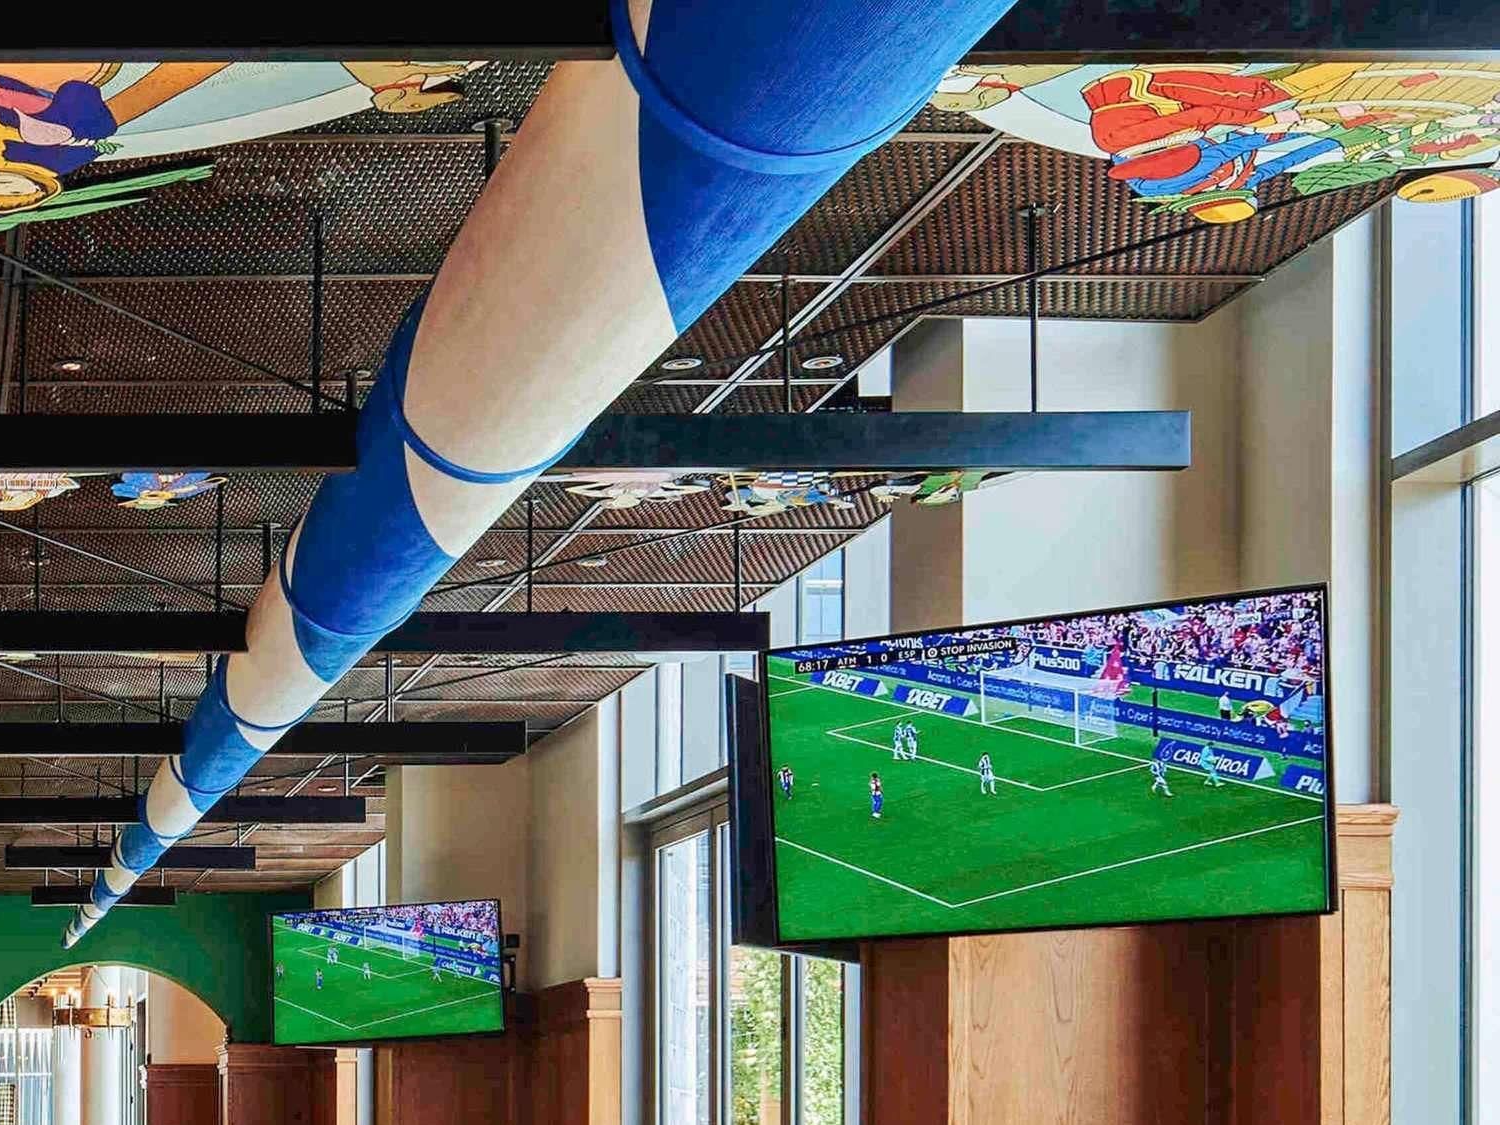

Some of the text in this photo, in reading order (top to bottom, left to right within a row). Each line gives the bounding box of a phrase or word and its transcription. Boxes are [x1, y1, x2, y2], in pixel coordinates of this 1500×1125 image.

[940, 640, 1012, 656] STOP INVASION
[798, 650, 916, 673] 68:17 ATM 1 0 ESP
[1030, 651, 1081, 671] Plus500
[1174, 663, 1263, 692] FALKEN
